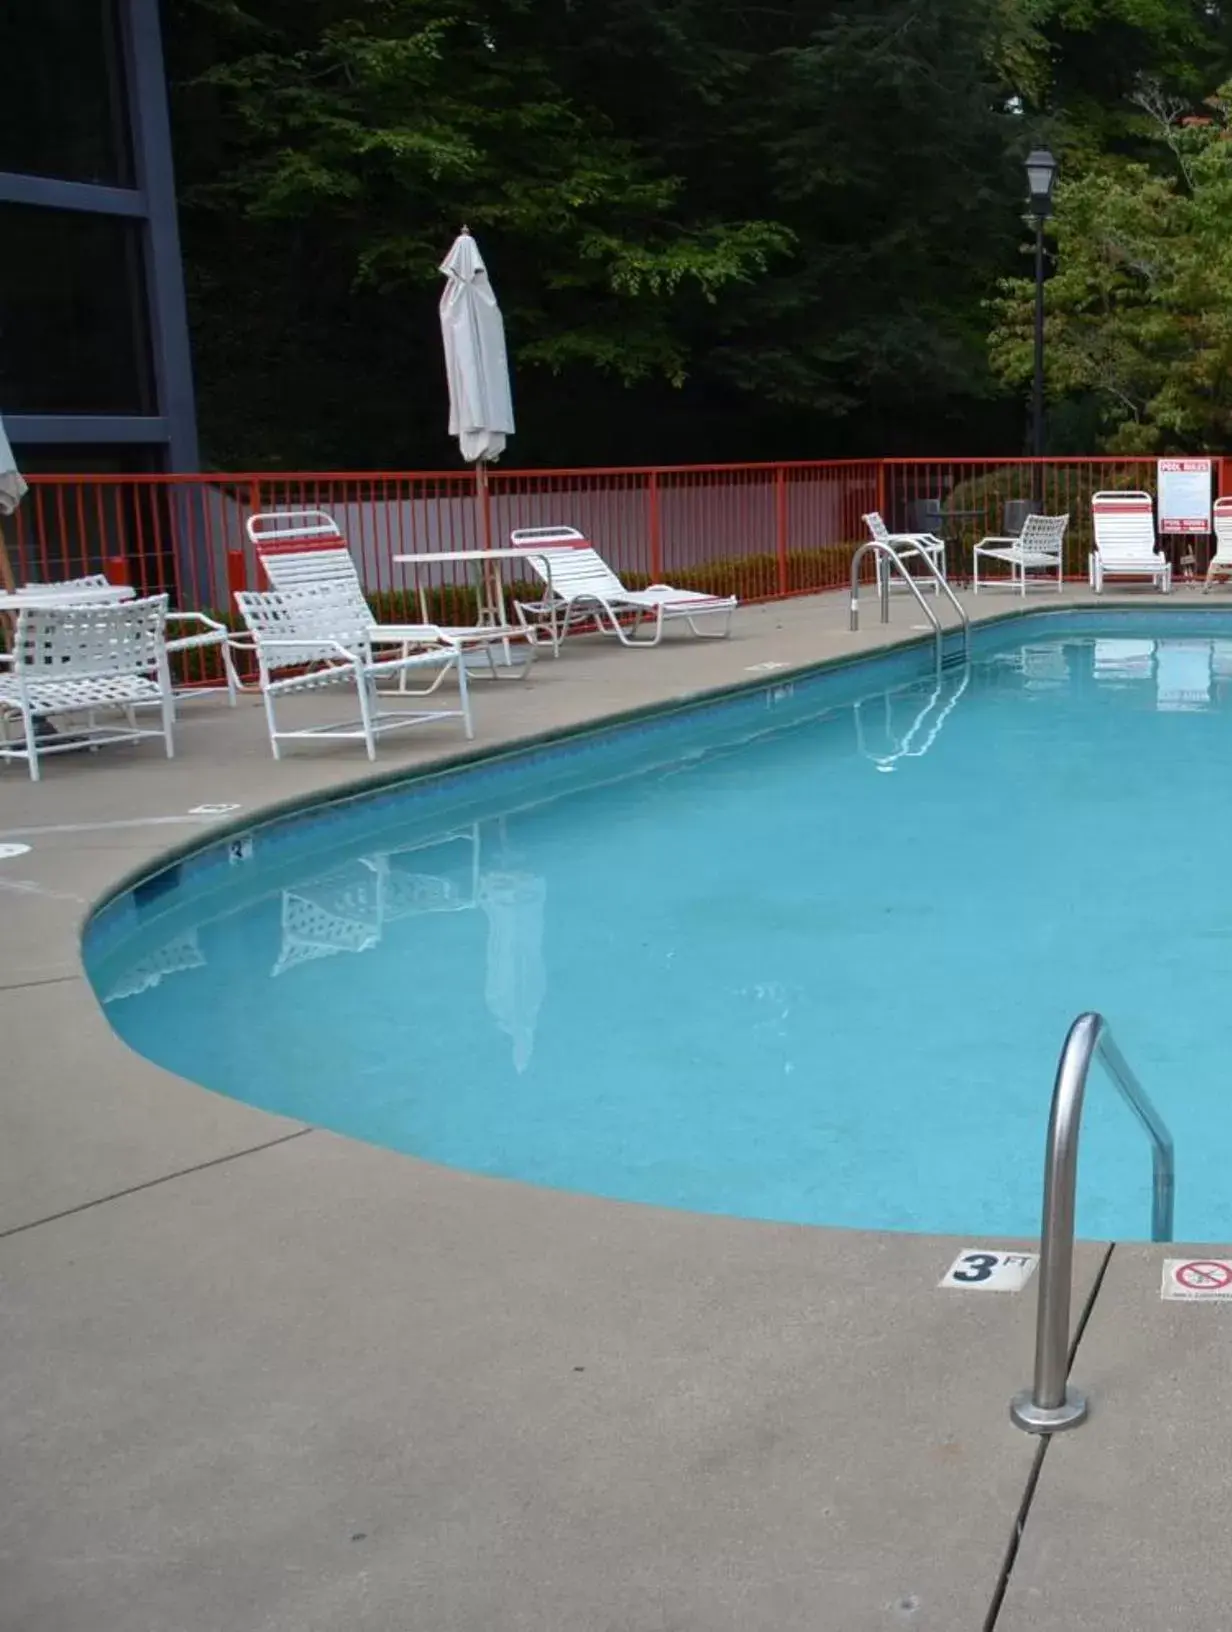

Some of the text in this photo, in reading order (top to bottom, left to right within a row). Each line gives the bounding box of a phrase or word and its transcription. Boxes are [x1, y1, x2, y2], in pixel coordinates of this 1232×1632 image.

[1161, 462, 1180, 471] POOL
[953, 1254, 1032, 1282] 3 FT
